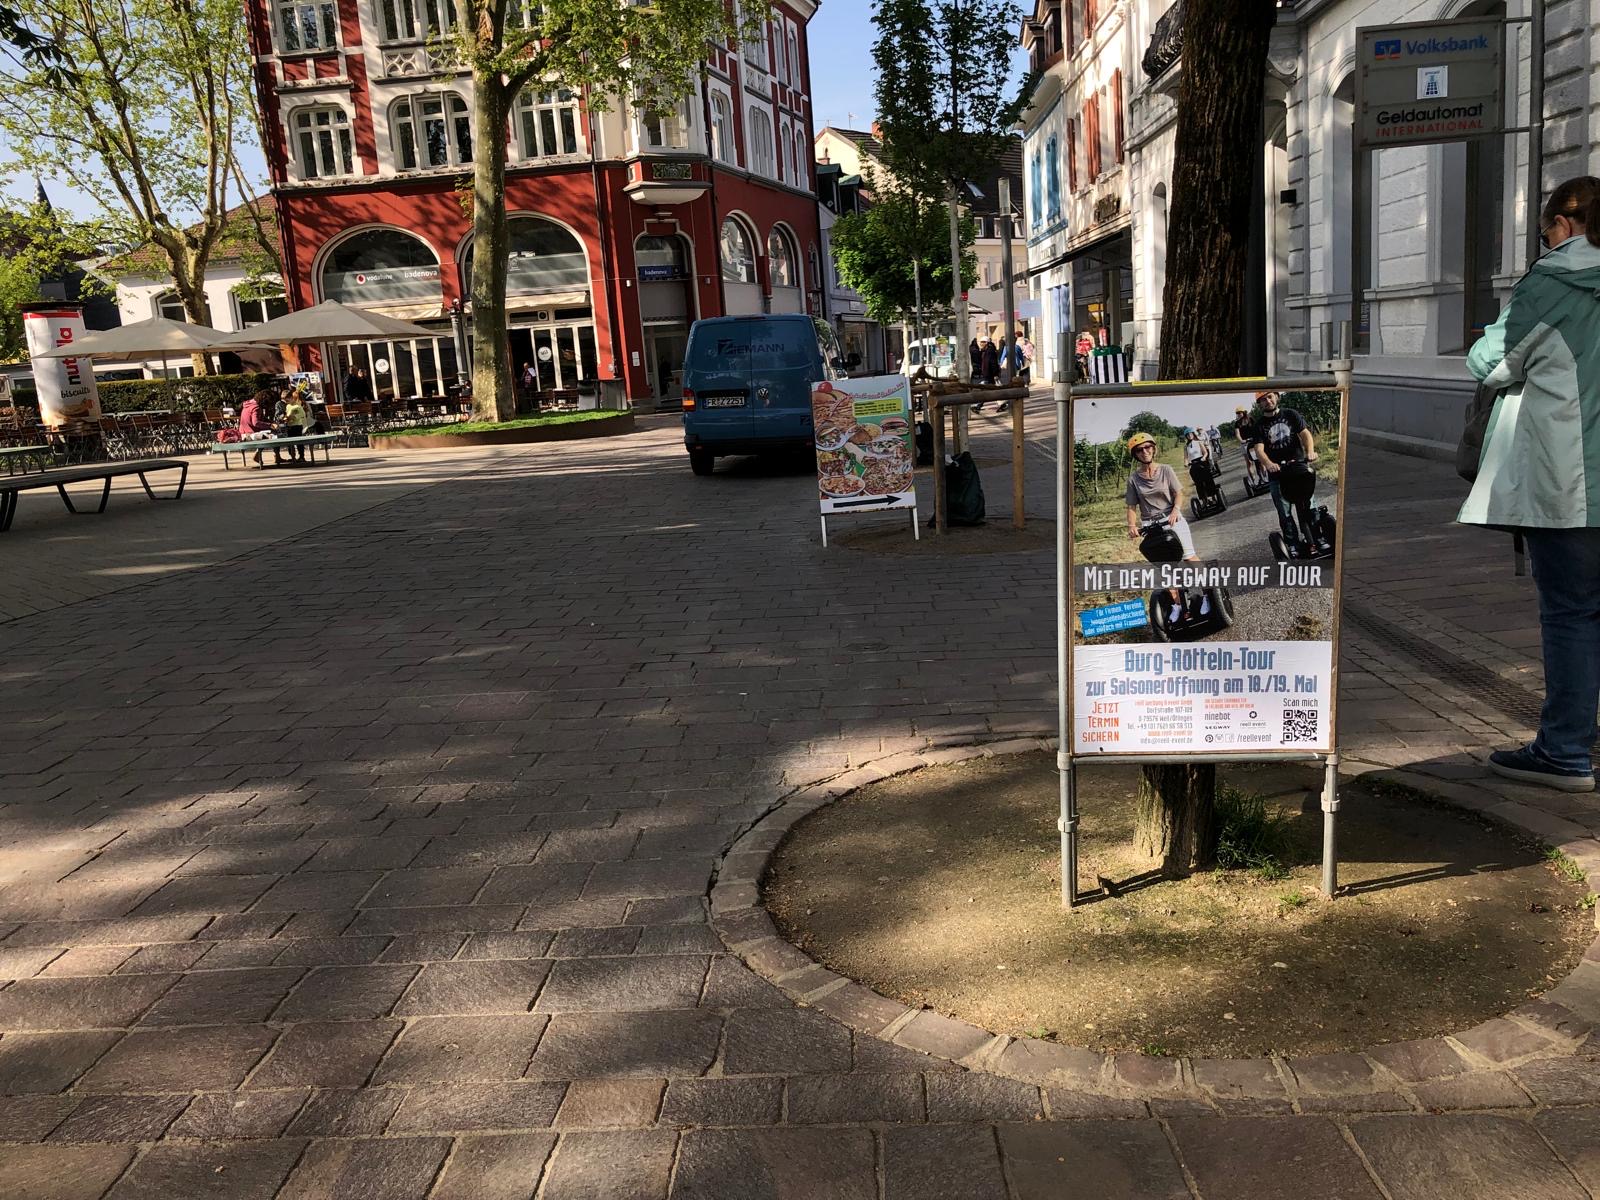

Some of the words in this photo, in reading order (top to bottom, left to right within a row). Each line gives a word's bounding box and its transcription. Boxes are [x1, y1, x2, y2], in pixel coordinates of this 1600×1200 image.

[1406, 35, 1489, 55] Volksbank
[1376, 103, 1484, 125] Geldautomat
[1376, 120, 1484, 137] INTERNATIONAL
[717, 339, 785, 355] ZIEMANN
[56, 328, 81, 385] nutla
[60, 386, 91, 399] biscuits
[1084, 566, 1113, 591] MIT
[1119, 568, 1155, 589] DEM
[1161, 563, 1231, 589] SEGWAY
[1237, 566, 1271, 587] AUF
[1278, 561, 1322, 587] TOUR
[1124, 647, 1276, 675] Burg-Rötteln-Tour
[1086, 680, 1106, 697] zur
[1110, 675, 1220, 697] Saisoneröffnung
[1223, 677, 1244, 692] am
[1294, 674, 1318, 693] Mai
[1092, 702, 1119, 714] JETZT
[1283, 698, 1300, 707] Scan
[1301, 698, 1319, 707] mich
[1088, 716, 1119, 728] TERMIN
[1204, 712, 1231, 720] ninebot
[1082, 732, 1119, 742] SICHERN
